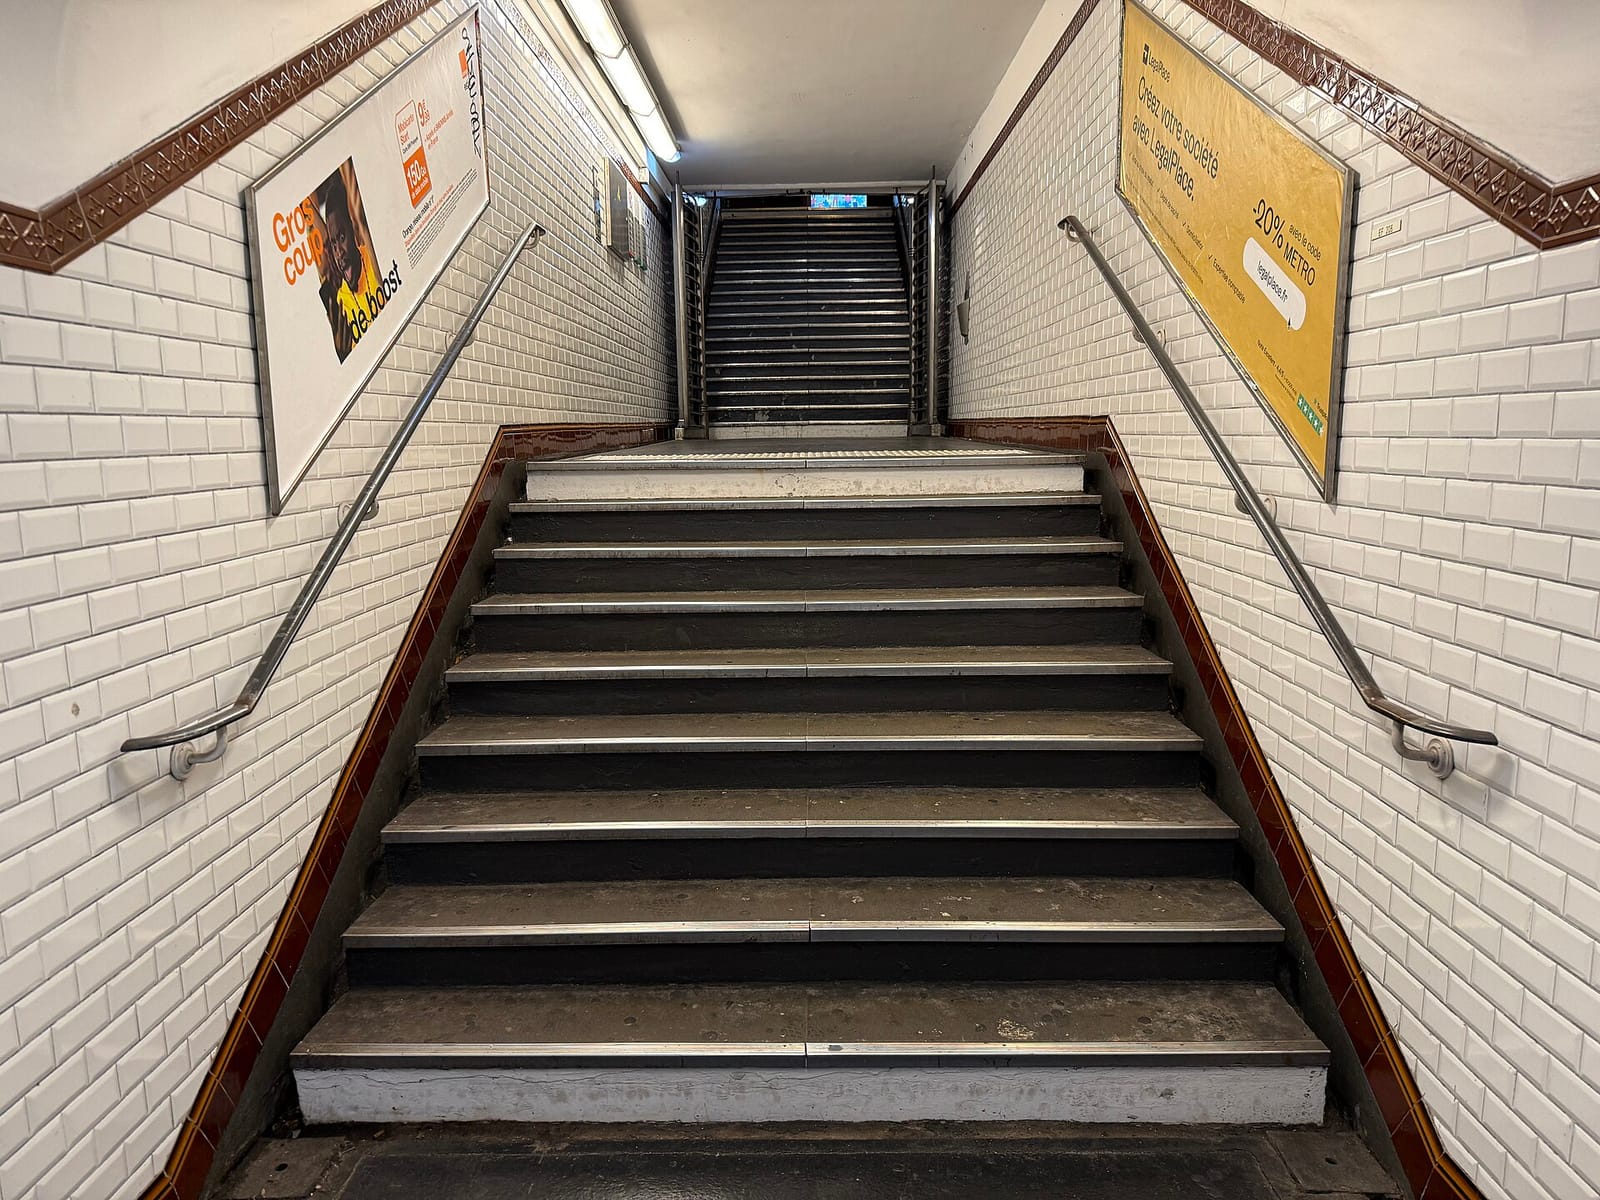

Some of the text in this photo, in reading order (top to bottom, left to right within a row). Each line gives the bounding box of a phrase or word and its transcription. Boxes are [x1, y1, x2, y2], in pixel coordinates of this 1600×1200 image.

[1148, 51, 1171, 83] LegalPlace
[1138, 76, 1219, 180] Créez votre société
[407, 160, 421, 188] 150
[1132, 114, 1150, 147] avec
[1149, 127, 1195, 201] LegalPlace.
[272, 197, 314, 253] Gros
[1252, 198, 1286, 249] -20%
[1288, 224, 1321, 261] avec le code
[284, 228, 324, 286] coup
[1256, 260, 1288, 303] legalplace.fr
[1283, 241, 1316, 287] METRO
[349, 258, 403, 345] de boost
